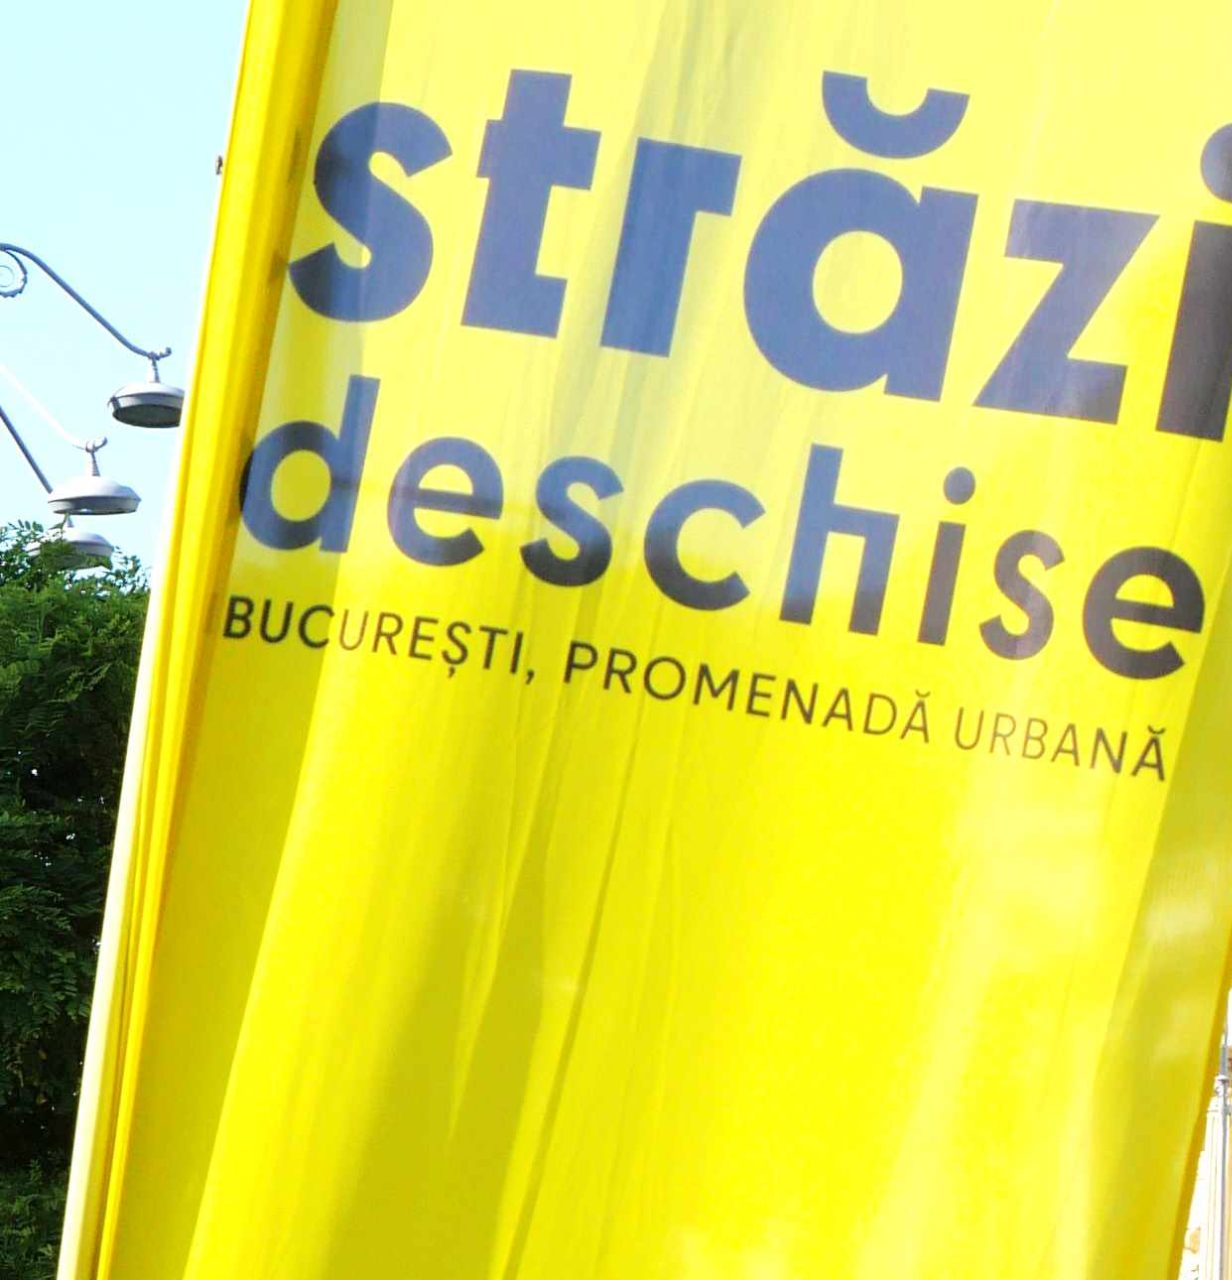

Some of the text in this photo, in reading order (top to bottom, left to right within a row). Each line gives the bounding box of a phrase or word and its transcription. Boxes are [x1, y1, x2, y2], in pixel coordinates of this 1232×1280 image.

[239, 376, 1206, 680] deschise
[221, 596, 1171, 783] BUCUREȘTI, PROMENADĂ URBANĂ
